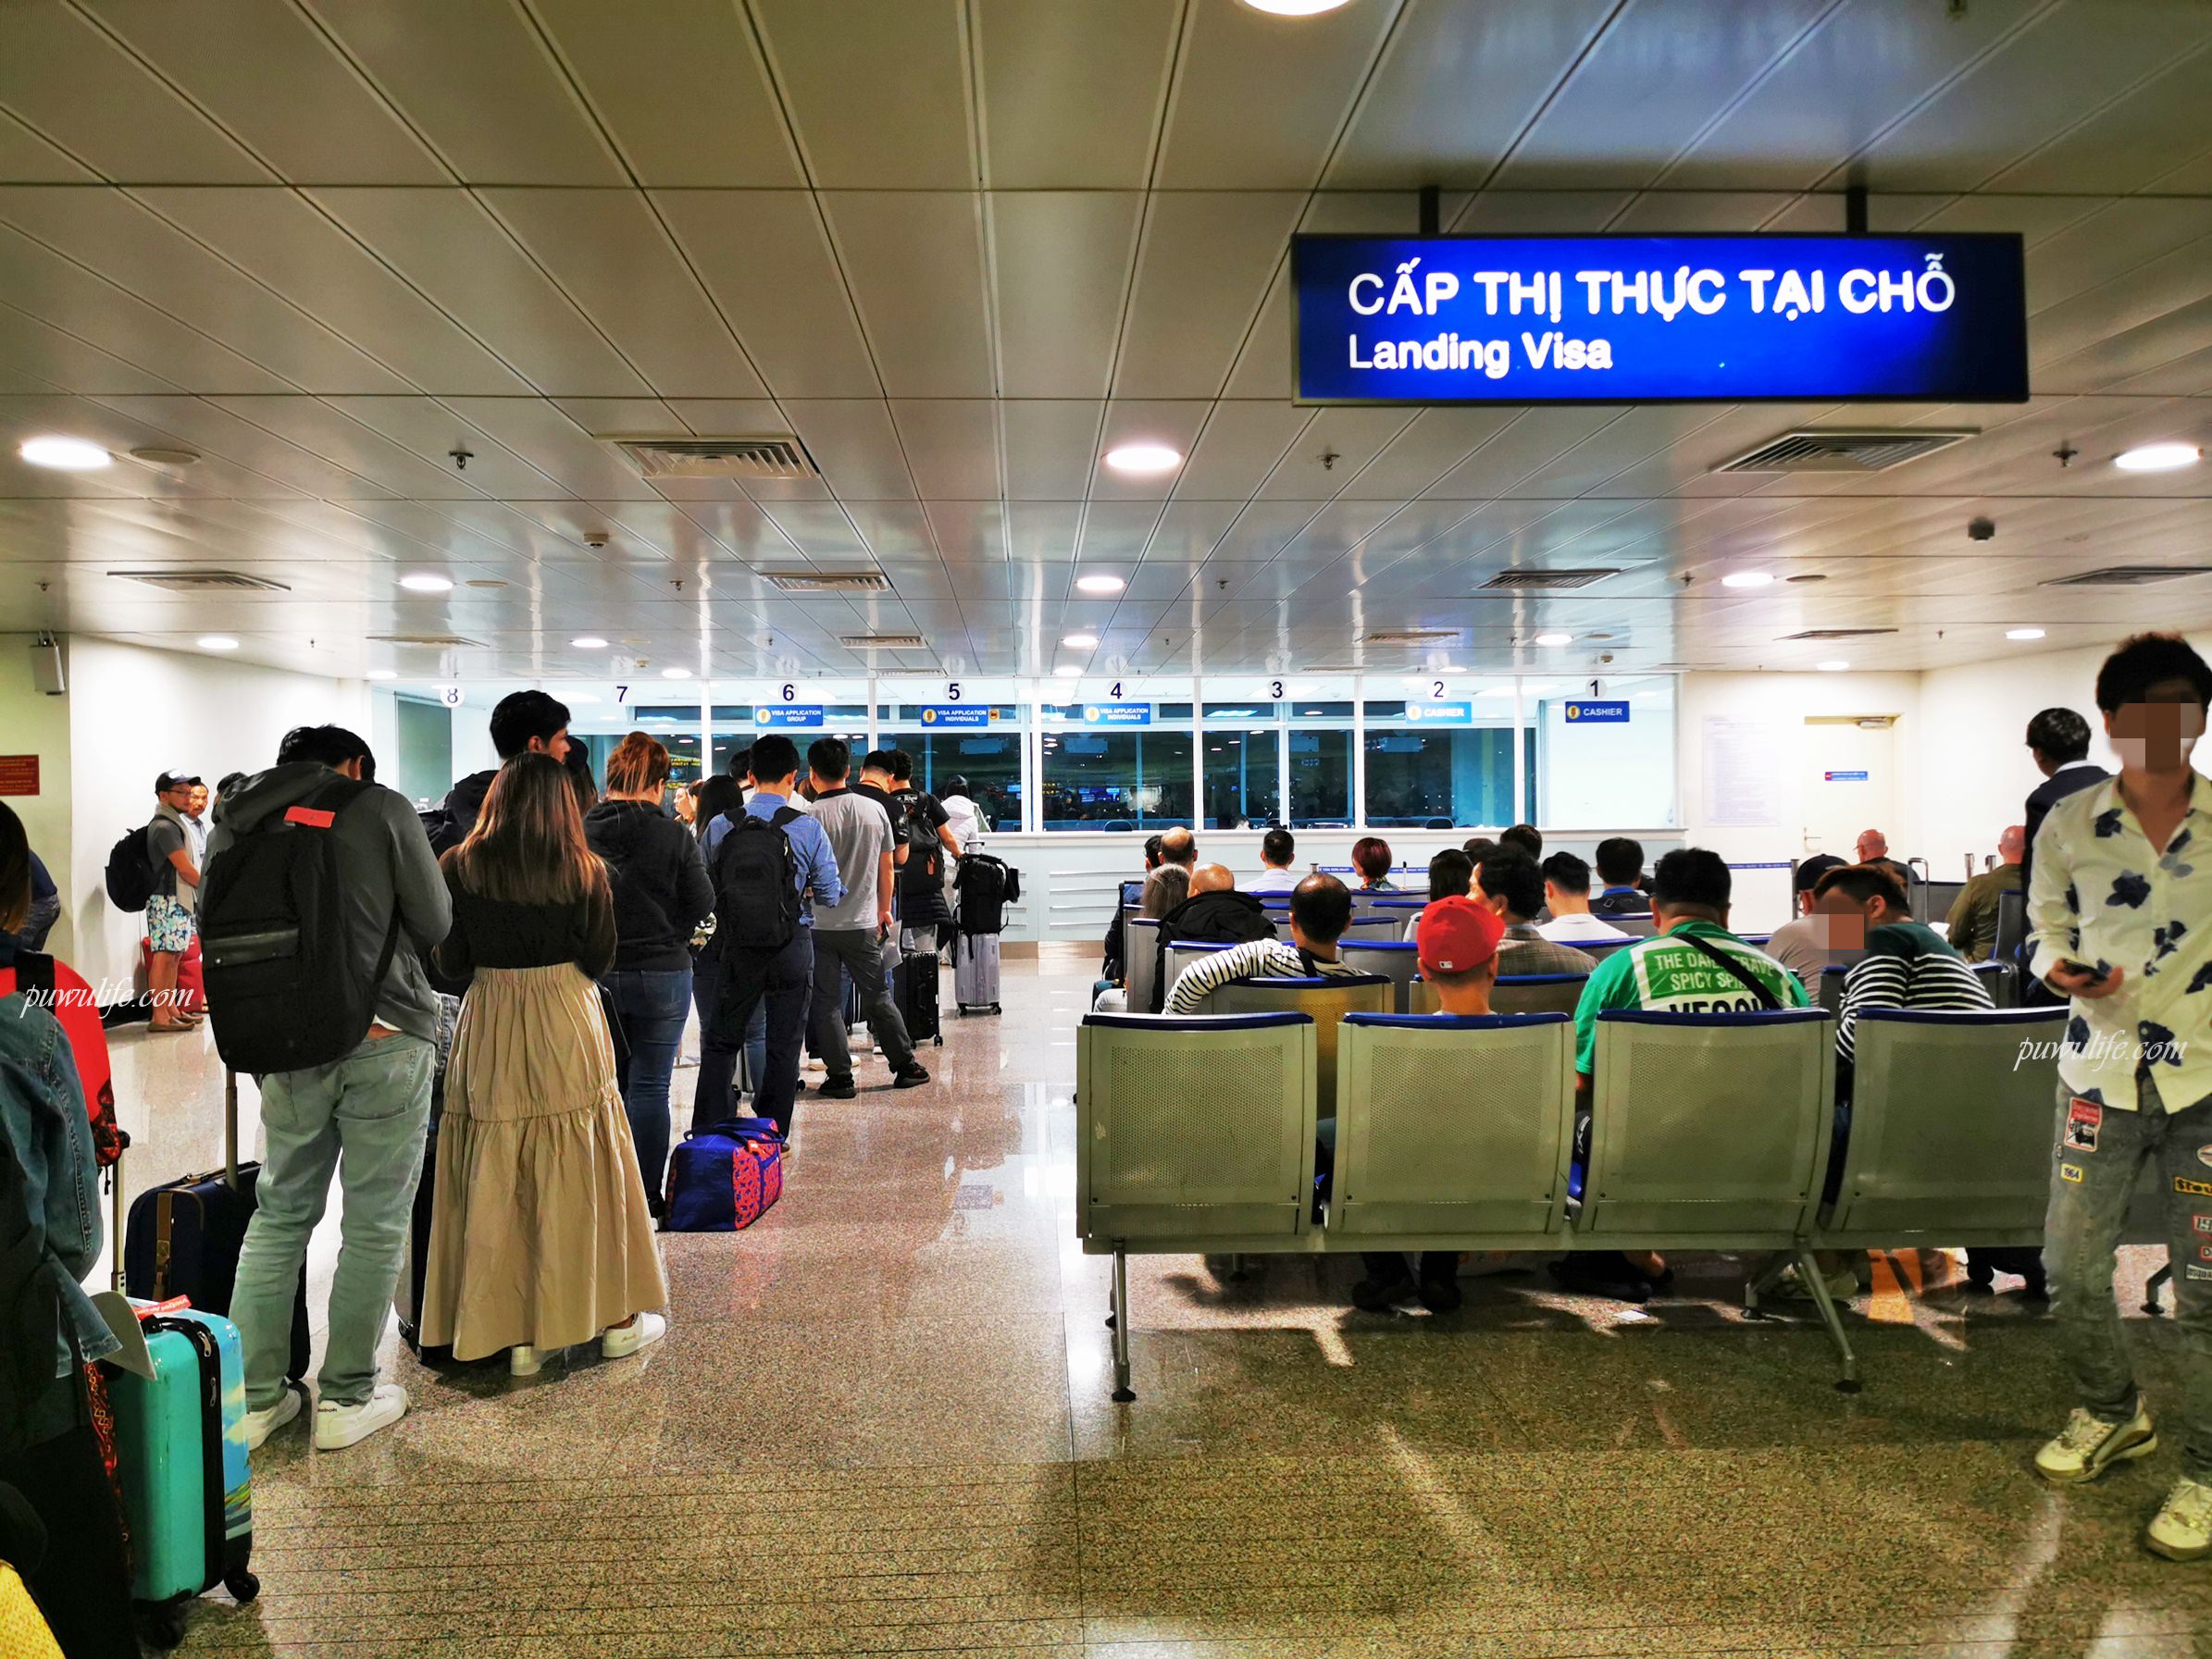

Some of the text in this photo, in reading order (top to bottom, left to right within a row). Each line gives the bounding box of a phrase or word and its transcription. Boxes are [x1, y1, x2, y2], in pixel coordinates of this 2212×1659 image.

[1348, 253, 1956, 324] CẤP THỊ THỰC TẠI CHỖ
[1348, 331, 1614, 380] Landing Visa
[447, 687, 458, 704] 8
[616, 686, 628, 703] 7
[782, 684, 795, 701] 6
[949, 683, 960, 700] 5
[1110, 682, 1123, 700] 4
[1272, 681, 1283, 699] 3
[1434, 681, 1444, 698] 2
[1590, 679, 1598, 698] 1
[1583, 708, 1622, 716] CASHIER
[1654, 953, 1685, 971] THE
[1670, 972, 1712, 991] SPICY
